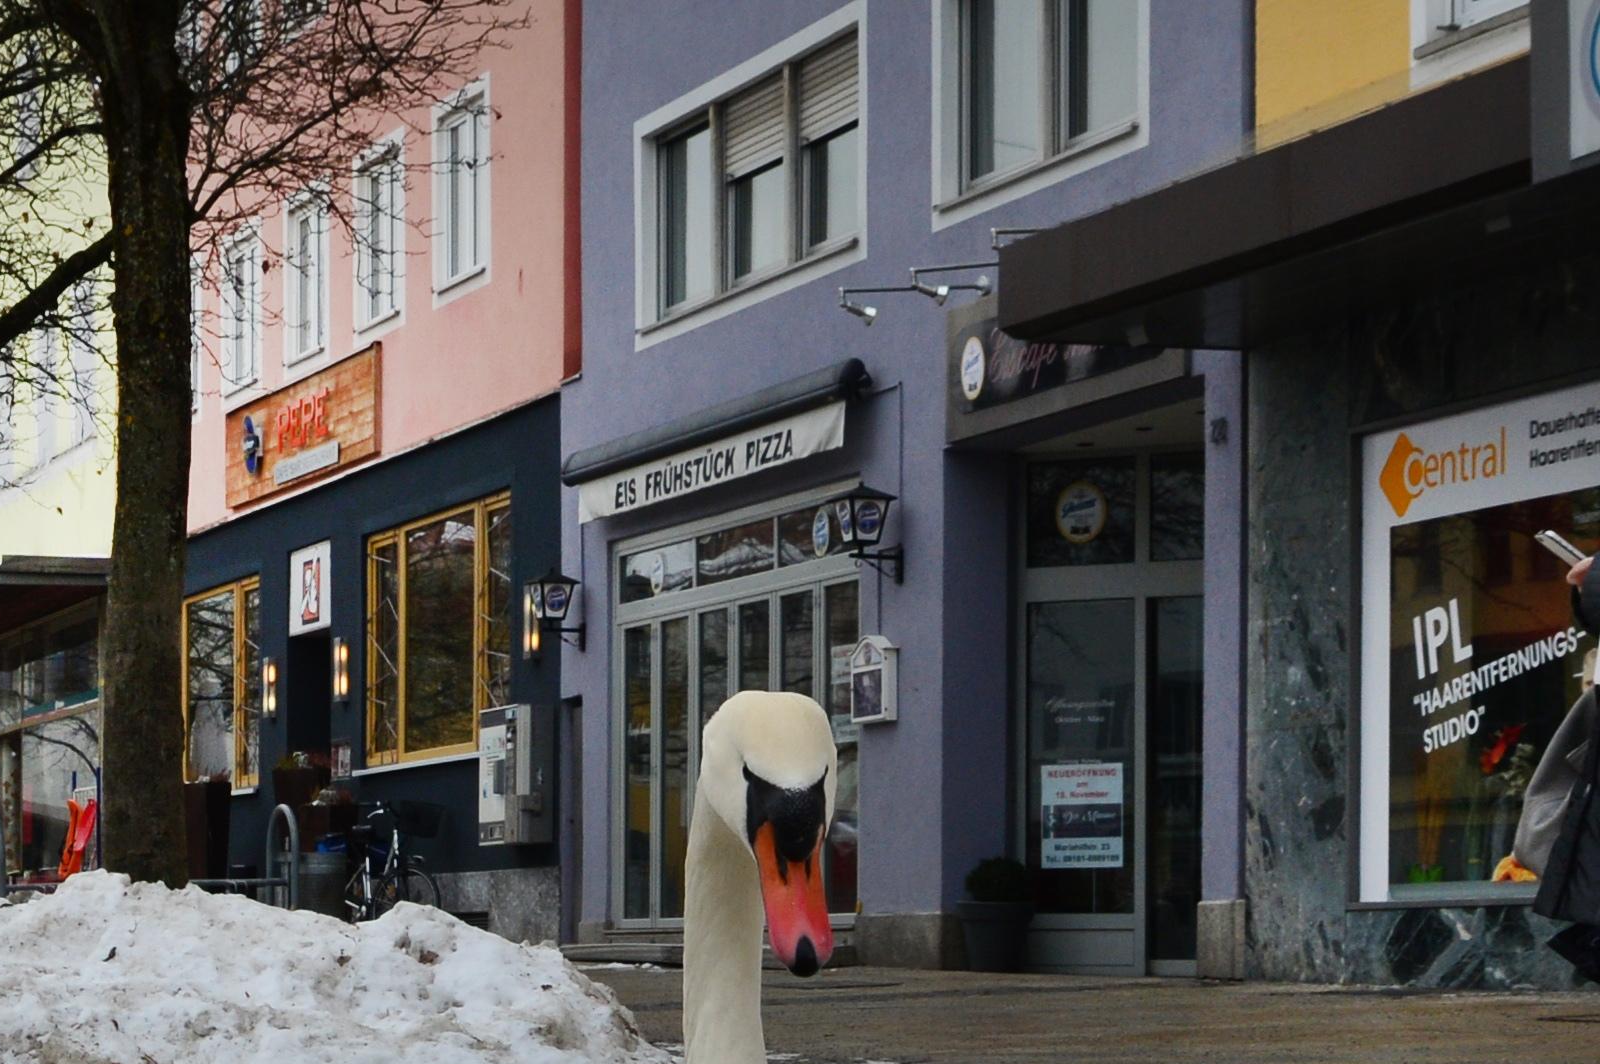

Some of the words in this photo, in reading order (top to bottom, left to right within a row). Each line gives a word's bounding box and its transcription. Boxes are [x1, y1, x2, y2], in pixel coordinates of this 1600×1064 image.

[615, 478, 637, 510] EIS
[645, 446, 737, 501] FRÜHSTÜCK
[746, 429, 793, 469] PIZZA
[1403, 426, 1507, 499] Central
[1413, 598, 1473, 680] IPL
